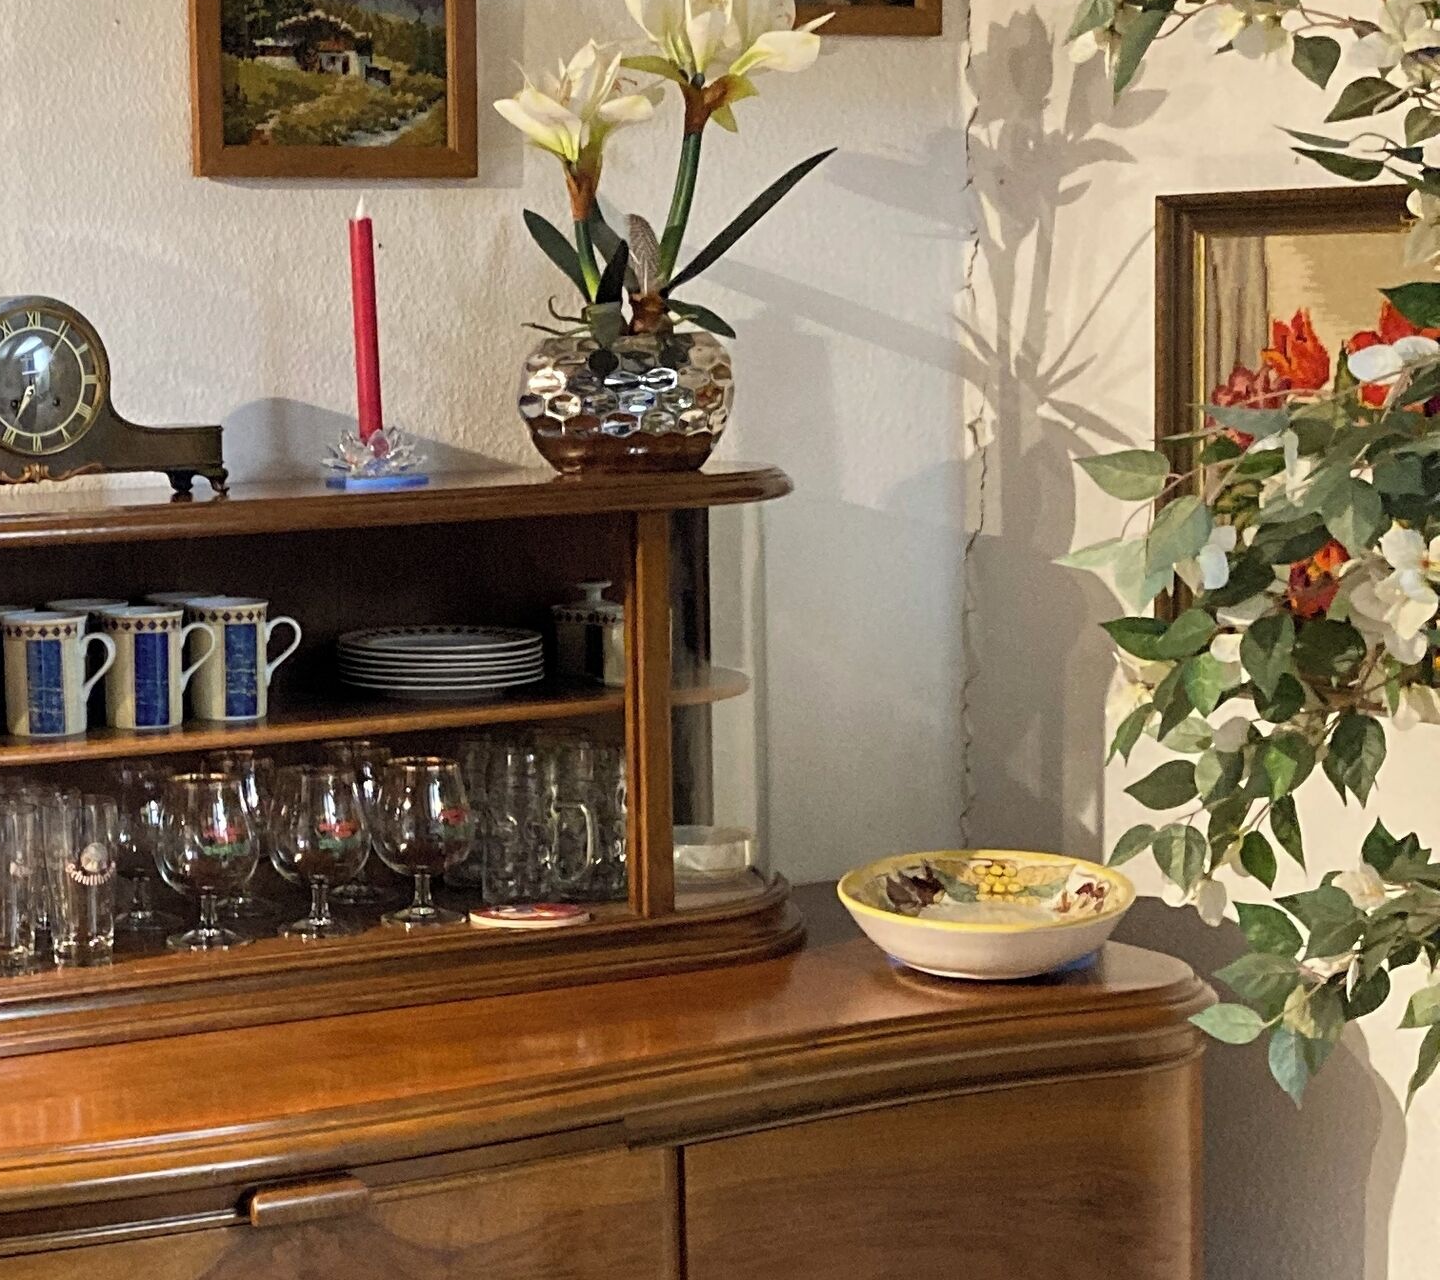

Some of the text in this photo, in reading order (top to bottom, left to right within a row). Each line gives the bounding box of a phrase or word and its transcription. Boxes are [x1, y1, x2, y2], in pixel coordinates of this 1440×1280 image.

[26, 311, 41, 328] XII
[2, 427, 17, 446] VII
[60, 426, 71, 443] V
[32, 435, 43, 452] VI
